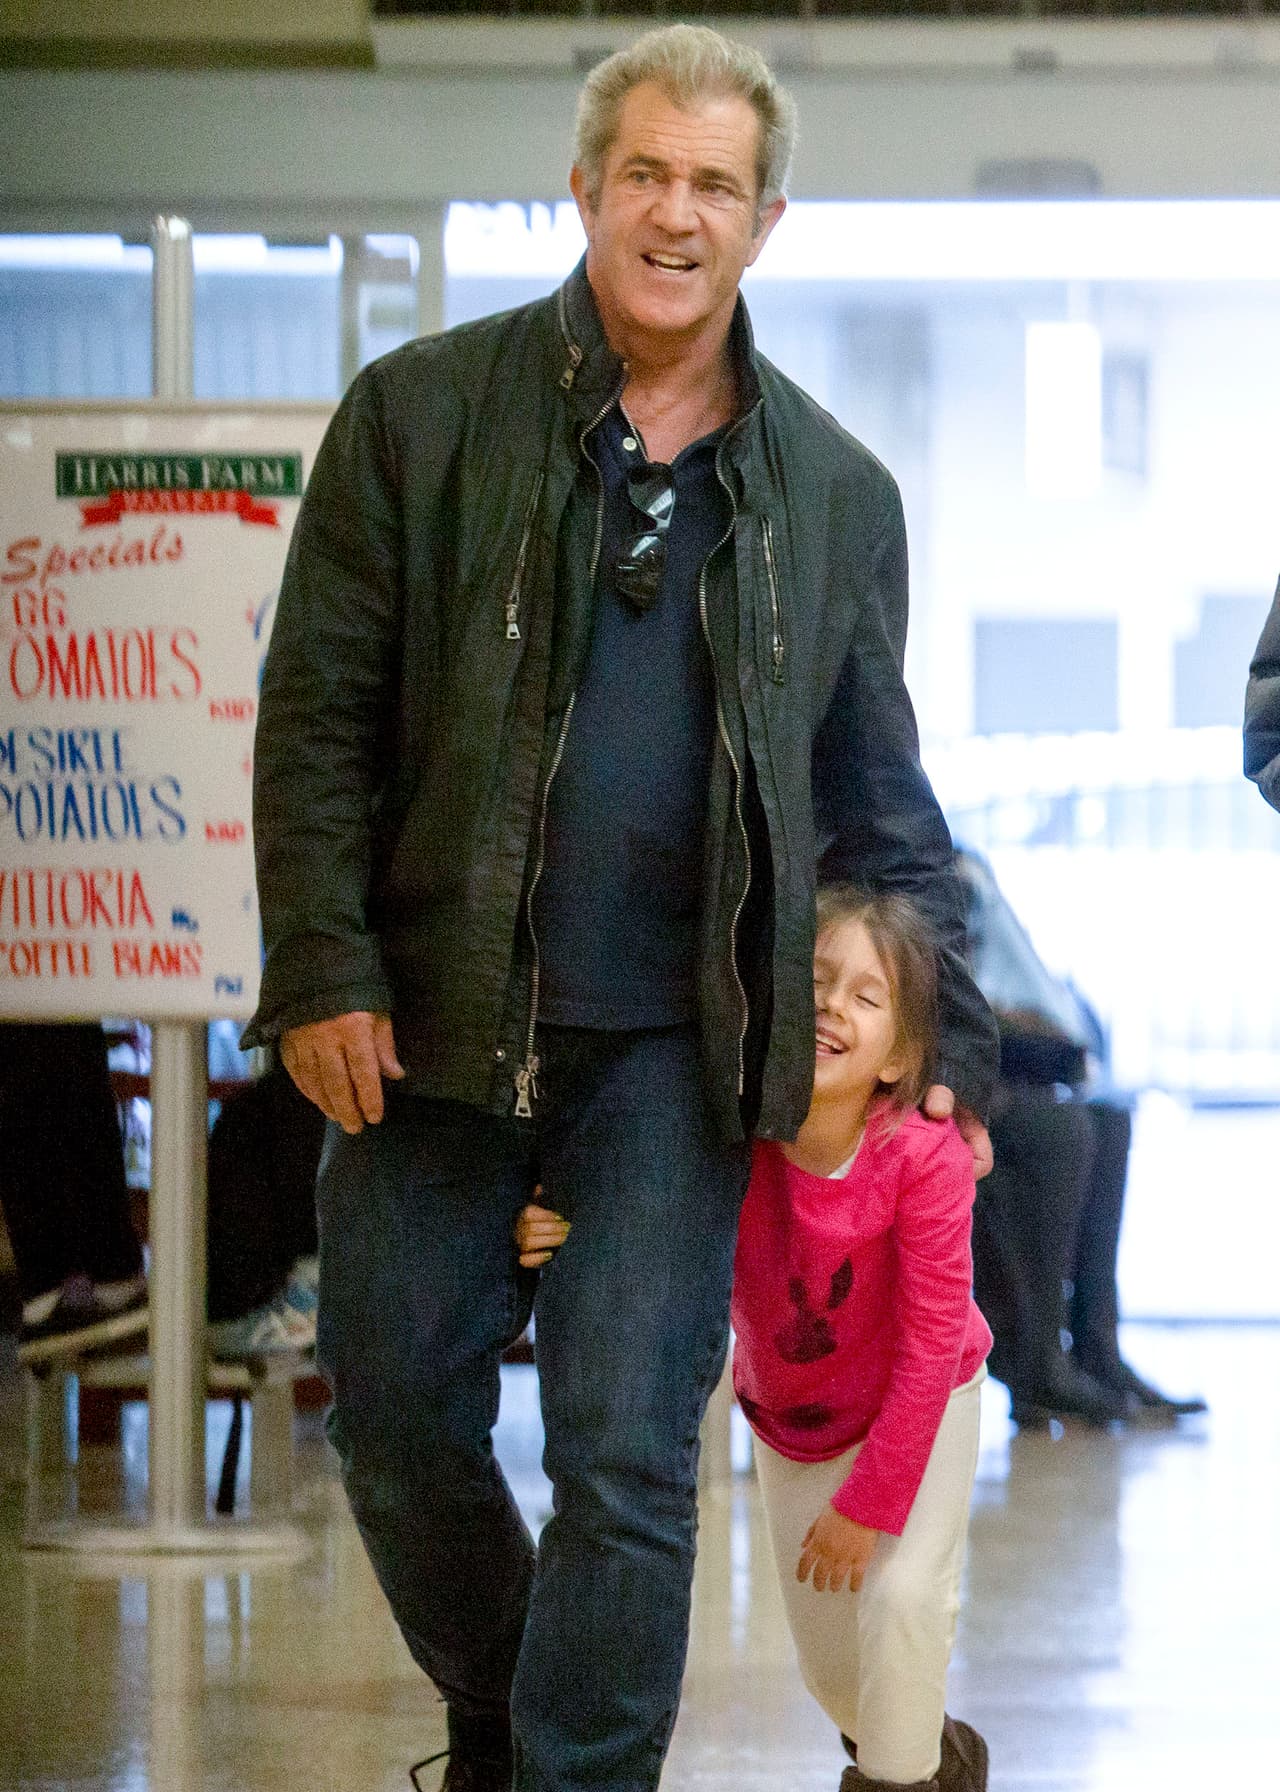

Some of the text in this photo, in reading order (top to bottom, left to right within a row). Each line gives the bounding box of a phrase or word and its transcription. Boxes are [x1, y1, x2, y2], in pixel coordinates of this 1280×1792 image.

[74, 459, 286, 489] HARRIS FARM
[1, 524, 183, 590] Specials
[0, 625, 202, 701] OMATOES
